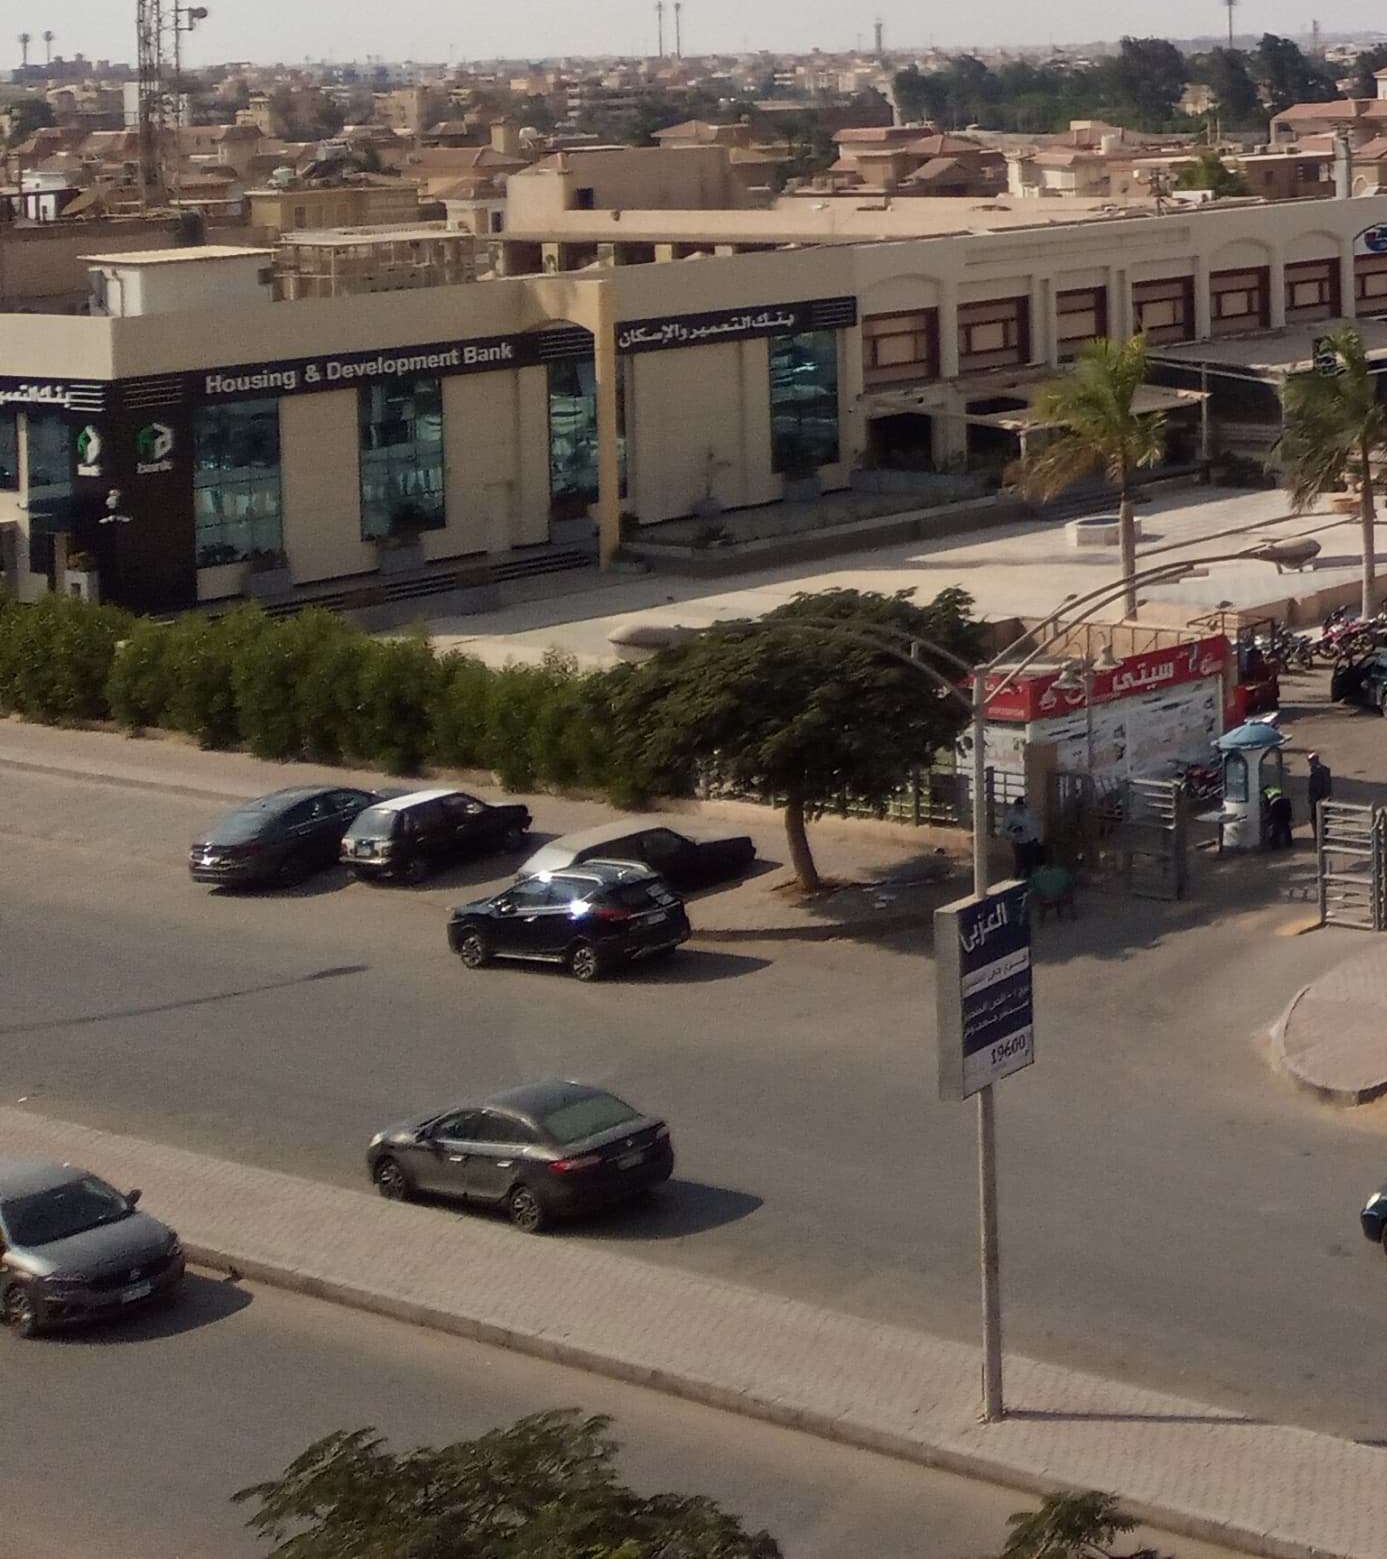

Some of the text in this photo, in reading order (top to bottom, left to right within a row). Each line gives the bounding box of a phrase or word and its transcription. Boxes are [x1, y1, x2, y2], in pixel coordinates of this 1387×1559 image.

[205, 342, 514, 395] Housing & Development Bank
[991, 1034, 1027, 1066] 19600
